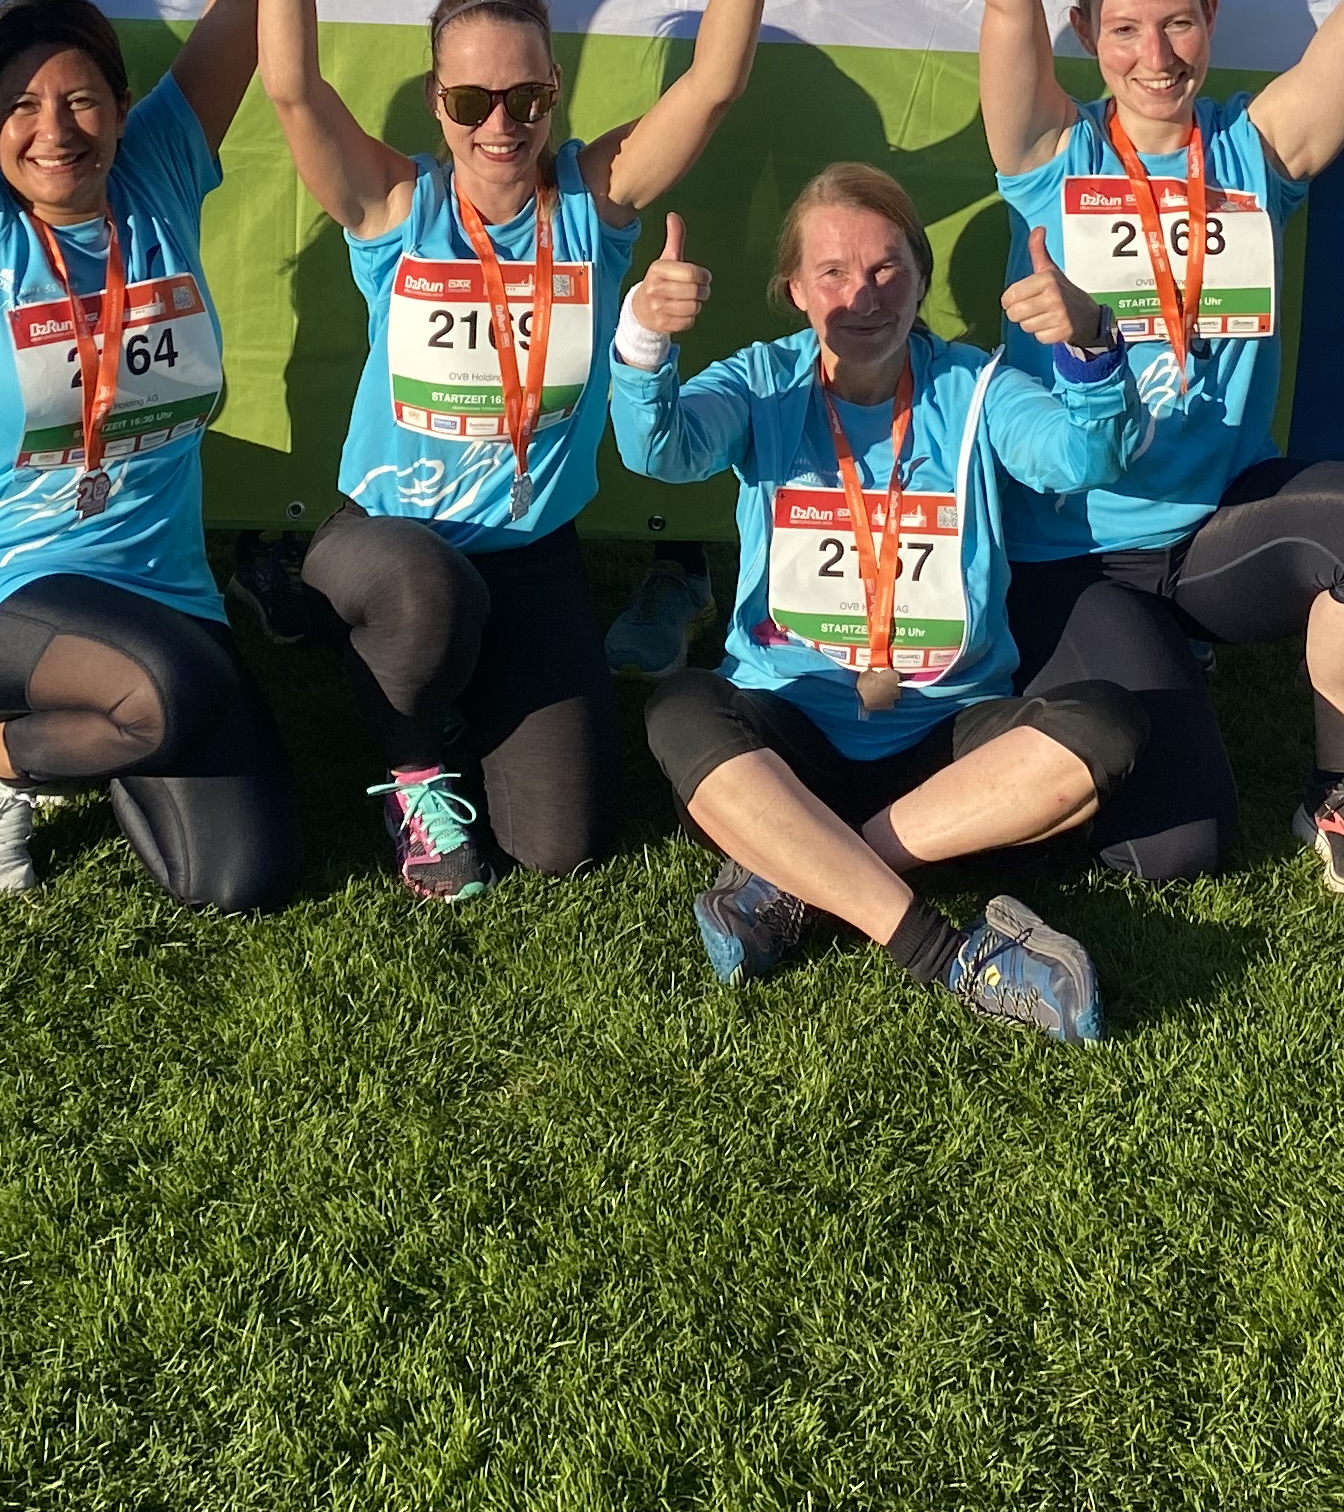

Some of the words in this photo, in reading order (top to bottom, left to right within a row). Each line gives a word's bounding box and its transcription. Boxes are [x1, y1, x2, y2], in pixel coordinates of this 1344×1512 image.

[1110, 217, 1226, 258] 268
[1118, 297, 1160, 308] STARTZ
[1204, 296, 1223, 306] Uhr
[67, 328, 179, 389] 264
[448, 372, 469, 381] OVB
[146, 393, 159, 404] AG
[431, 391, 486, 404] STARTZEIT
[490, 394, 506, 405] 16:
[156, 411, 173, 421] Uhr
[839, 602, 859, 611] OVB
[895, 604, 909, 614] AG
[820, 623, 868, 635] STARTZE
[908, 629, 926, 638] Uhr
